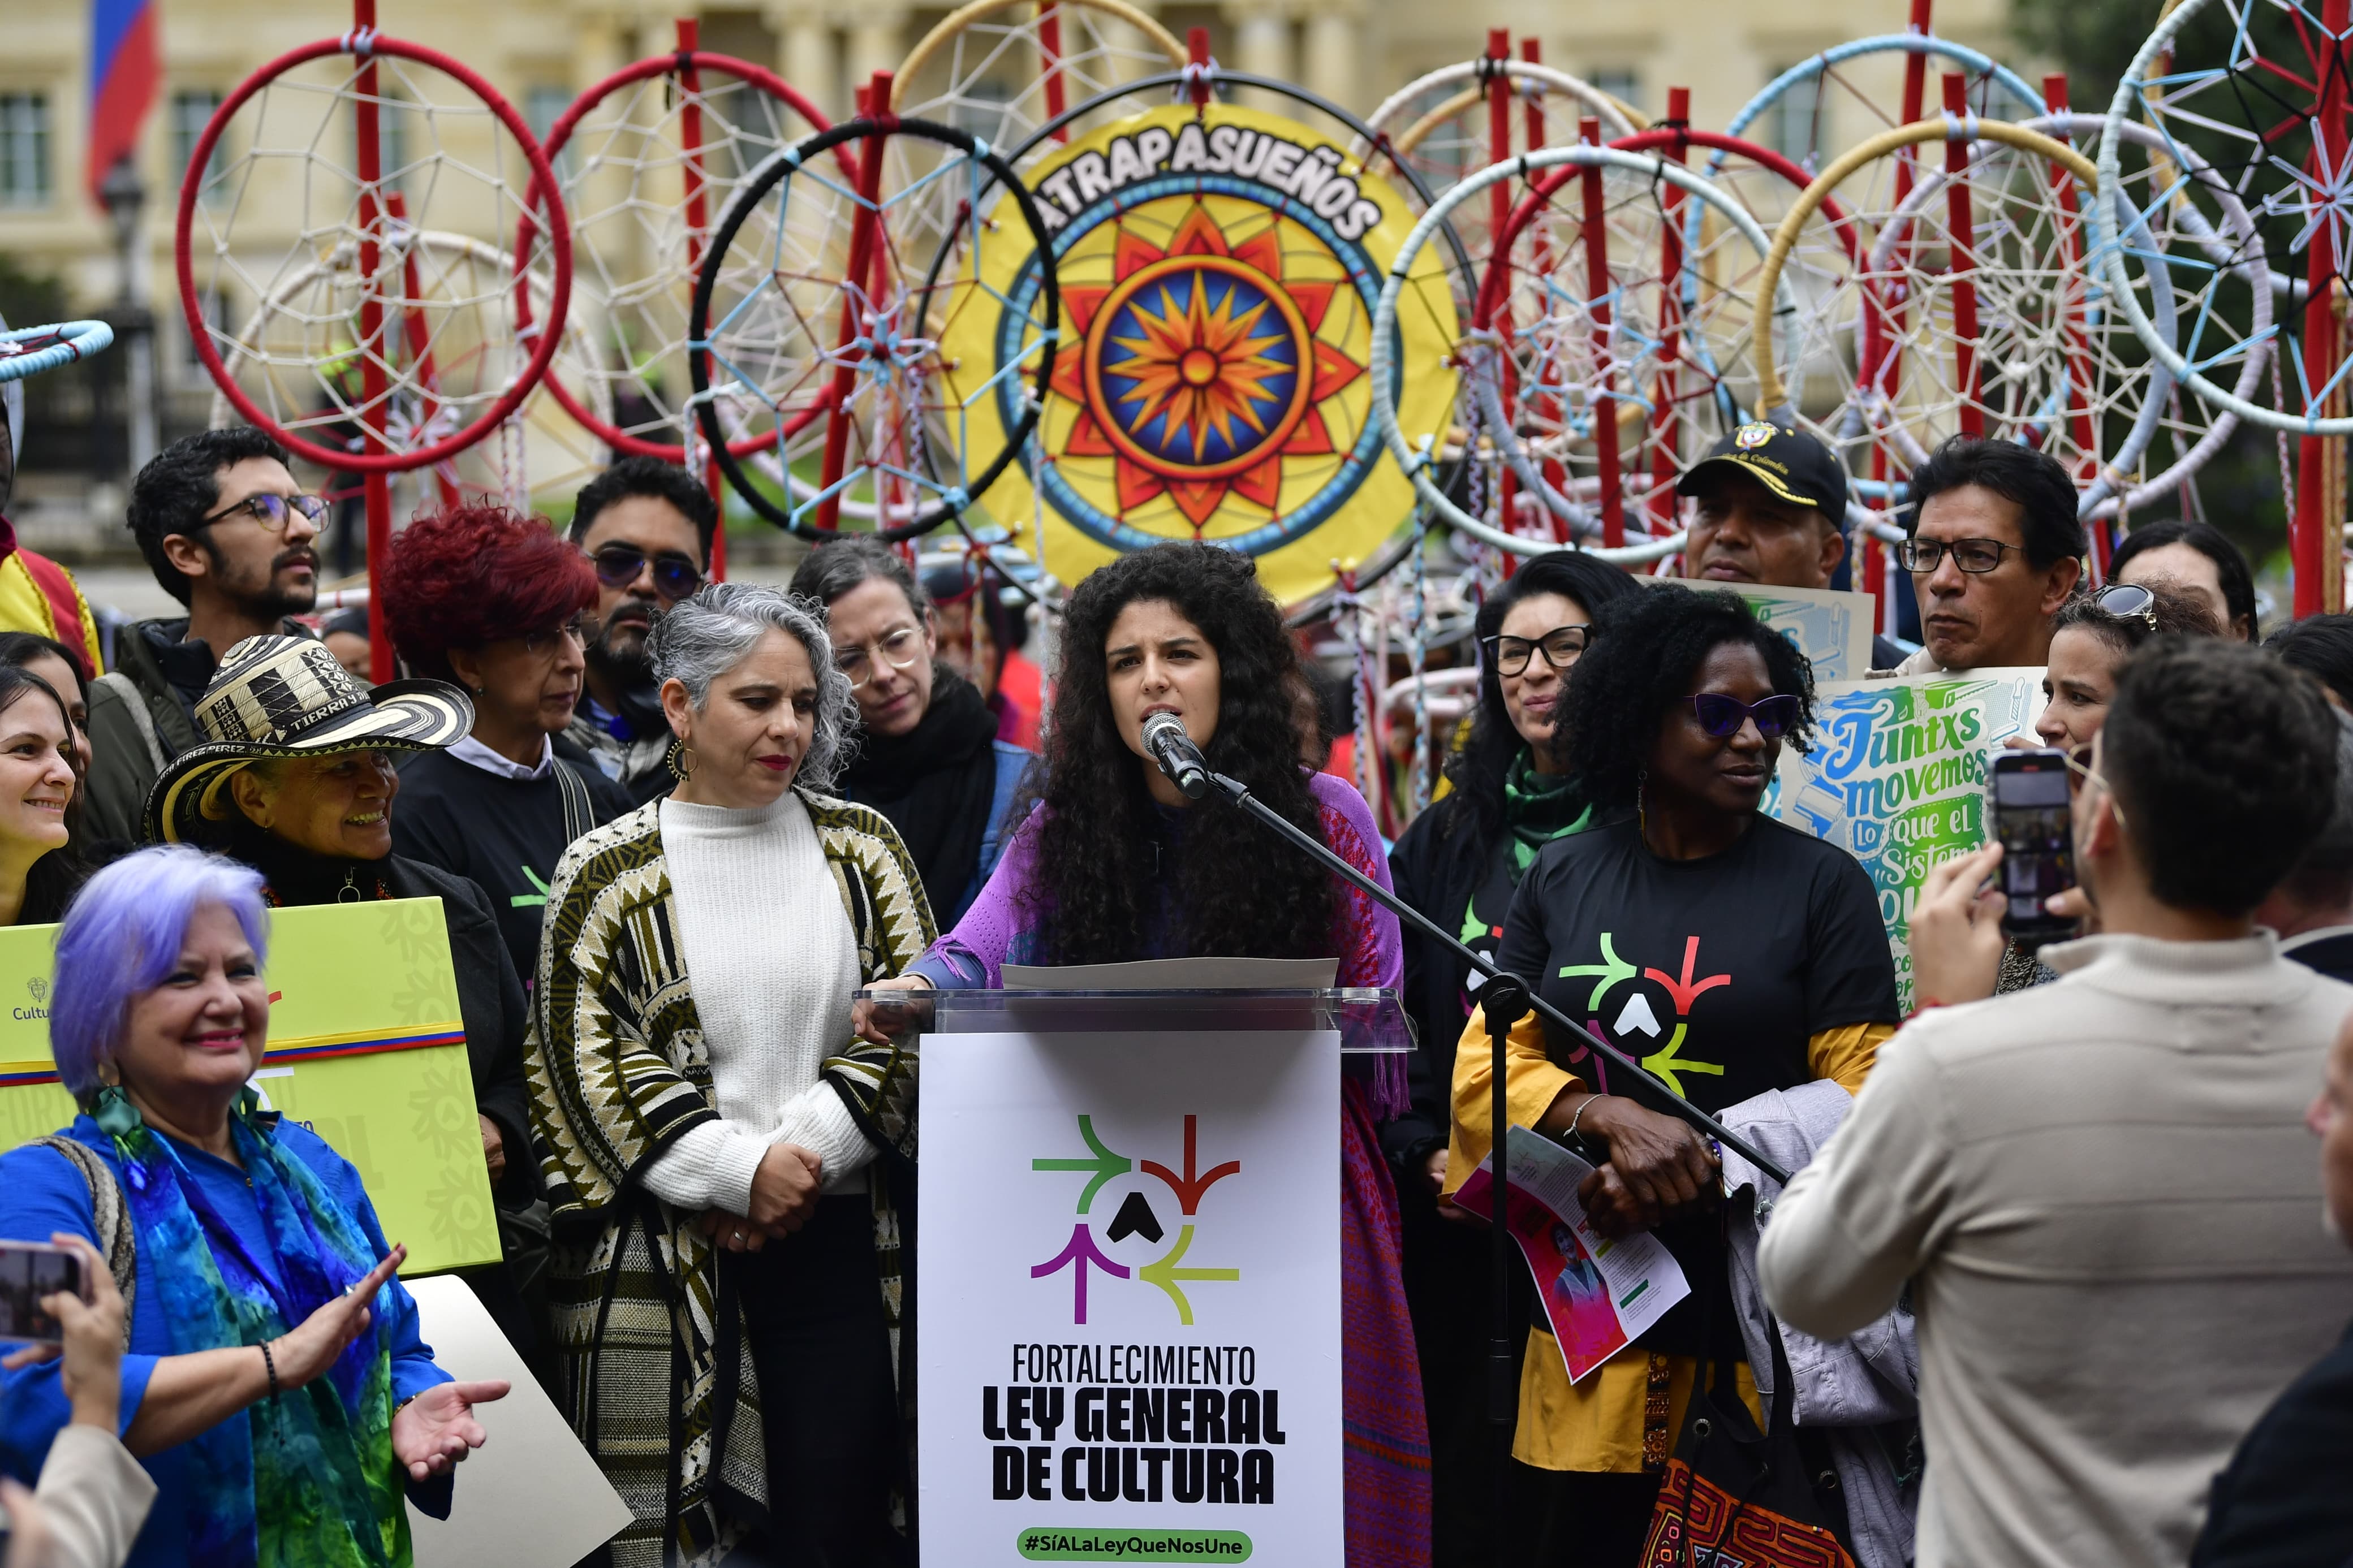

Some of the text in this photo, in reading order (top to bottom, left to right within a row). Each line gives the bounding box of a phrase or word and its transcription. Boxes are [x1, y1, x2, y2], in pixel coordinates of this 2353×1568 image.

[1032, 124, 1382, 240] ATRAPASUEÑOS
[290, 697, 349, 731] TIERRA
[1825, 703, 1981, 780] Juntxs
[1842, 748, 1988, 819] movemos
[1893, 813, 1940, 847] que
[13, 1007, 50, 1020] Cultu
[1013, 1344, 1255, 1385] FORTALECIMIENTO
[983, 1386, 1286, 1445] LEY GENERAL
[993, 1446, 1274, 1505] DE CULTURA
[1024, 1534, 1243, 1556] #SíALaLeyQueNosUne
